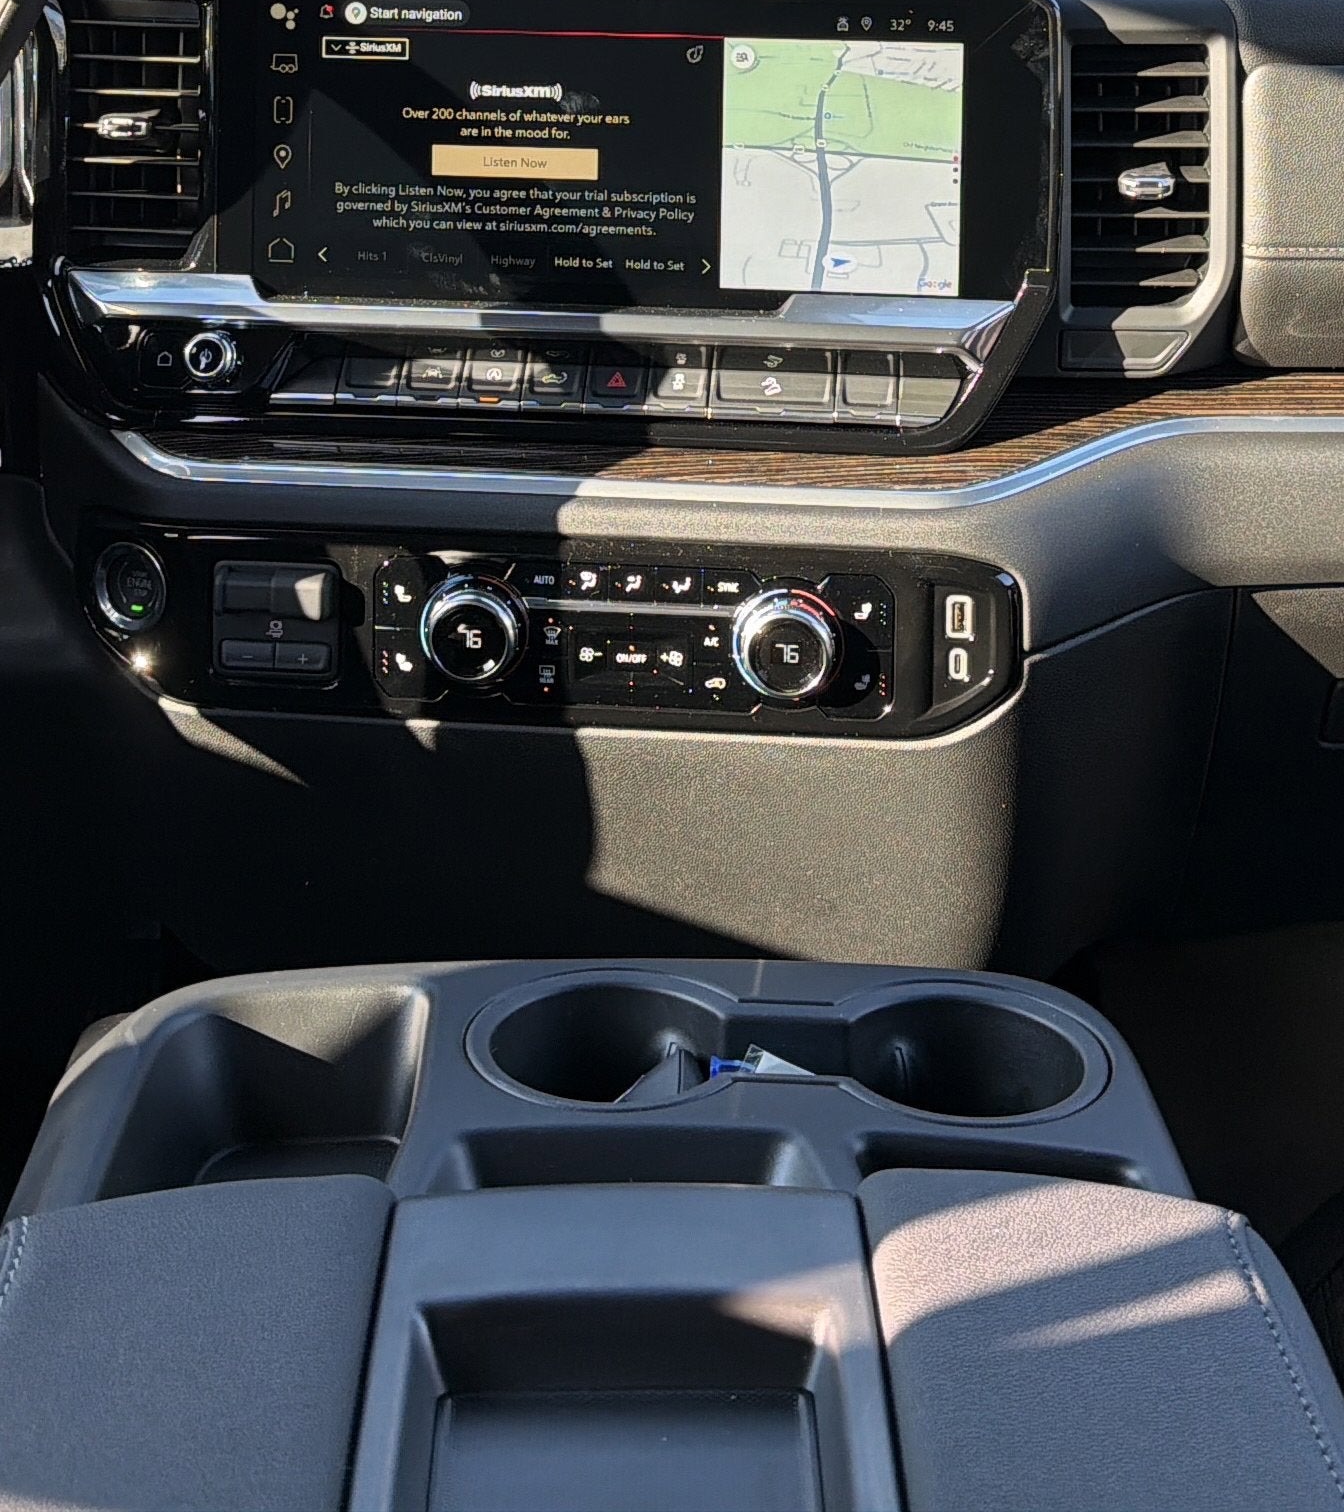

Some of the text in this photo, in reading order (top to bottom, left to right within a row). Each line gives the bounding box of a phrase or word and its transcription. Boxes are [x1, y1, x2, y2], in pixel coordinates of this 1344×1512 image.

[369, 7, 463, 23] Start navigation
[927, 19, 954, 32] 9:45
[359, 42, 402, 54] SiriusXM
[402, 107, 630, 126] Over 200 channels of whatever your ears
[460, 126, 570, 140] are in the mood for.
[483, 155, 547, 169] Listen Now
[334, 182, 696, 207] By clicking Listen Now, you agree that your trial subscription is
[336, 199, 695, 224] governed by SiriusXM's Customer Agreement & Privacy Policy
[373, 216, 656, 237] which you can view at siriusxm.com/agreements.
[357, 249, 379, 262] Hits
[490, 254, 535, 269] Highway
[554, 256, 613, 269] Hold to Set
[625, 258, 685, 272] Hold to Set
[917, 277, 952, 291] Google
[533, 575, 555, 586] AUTO
[717, 581, 740, 594] SYNC
[703, 636, 719, 648] A/C
[615, 652, 647, 665] ON/OFF
[775, 644, 800, 664] 76
